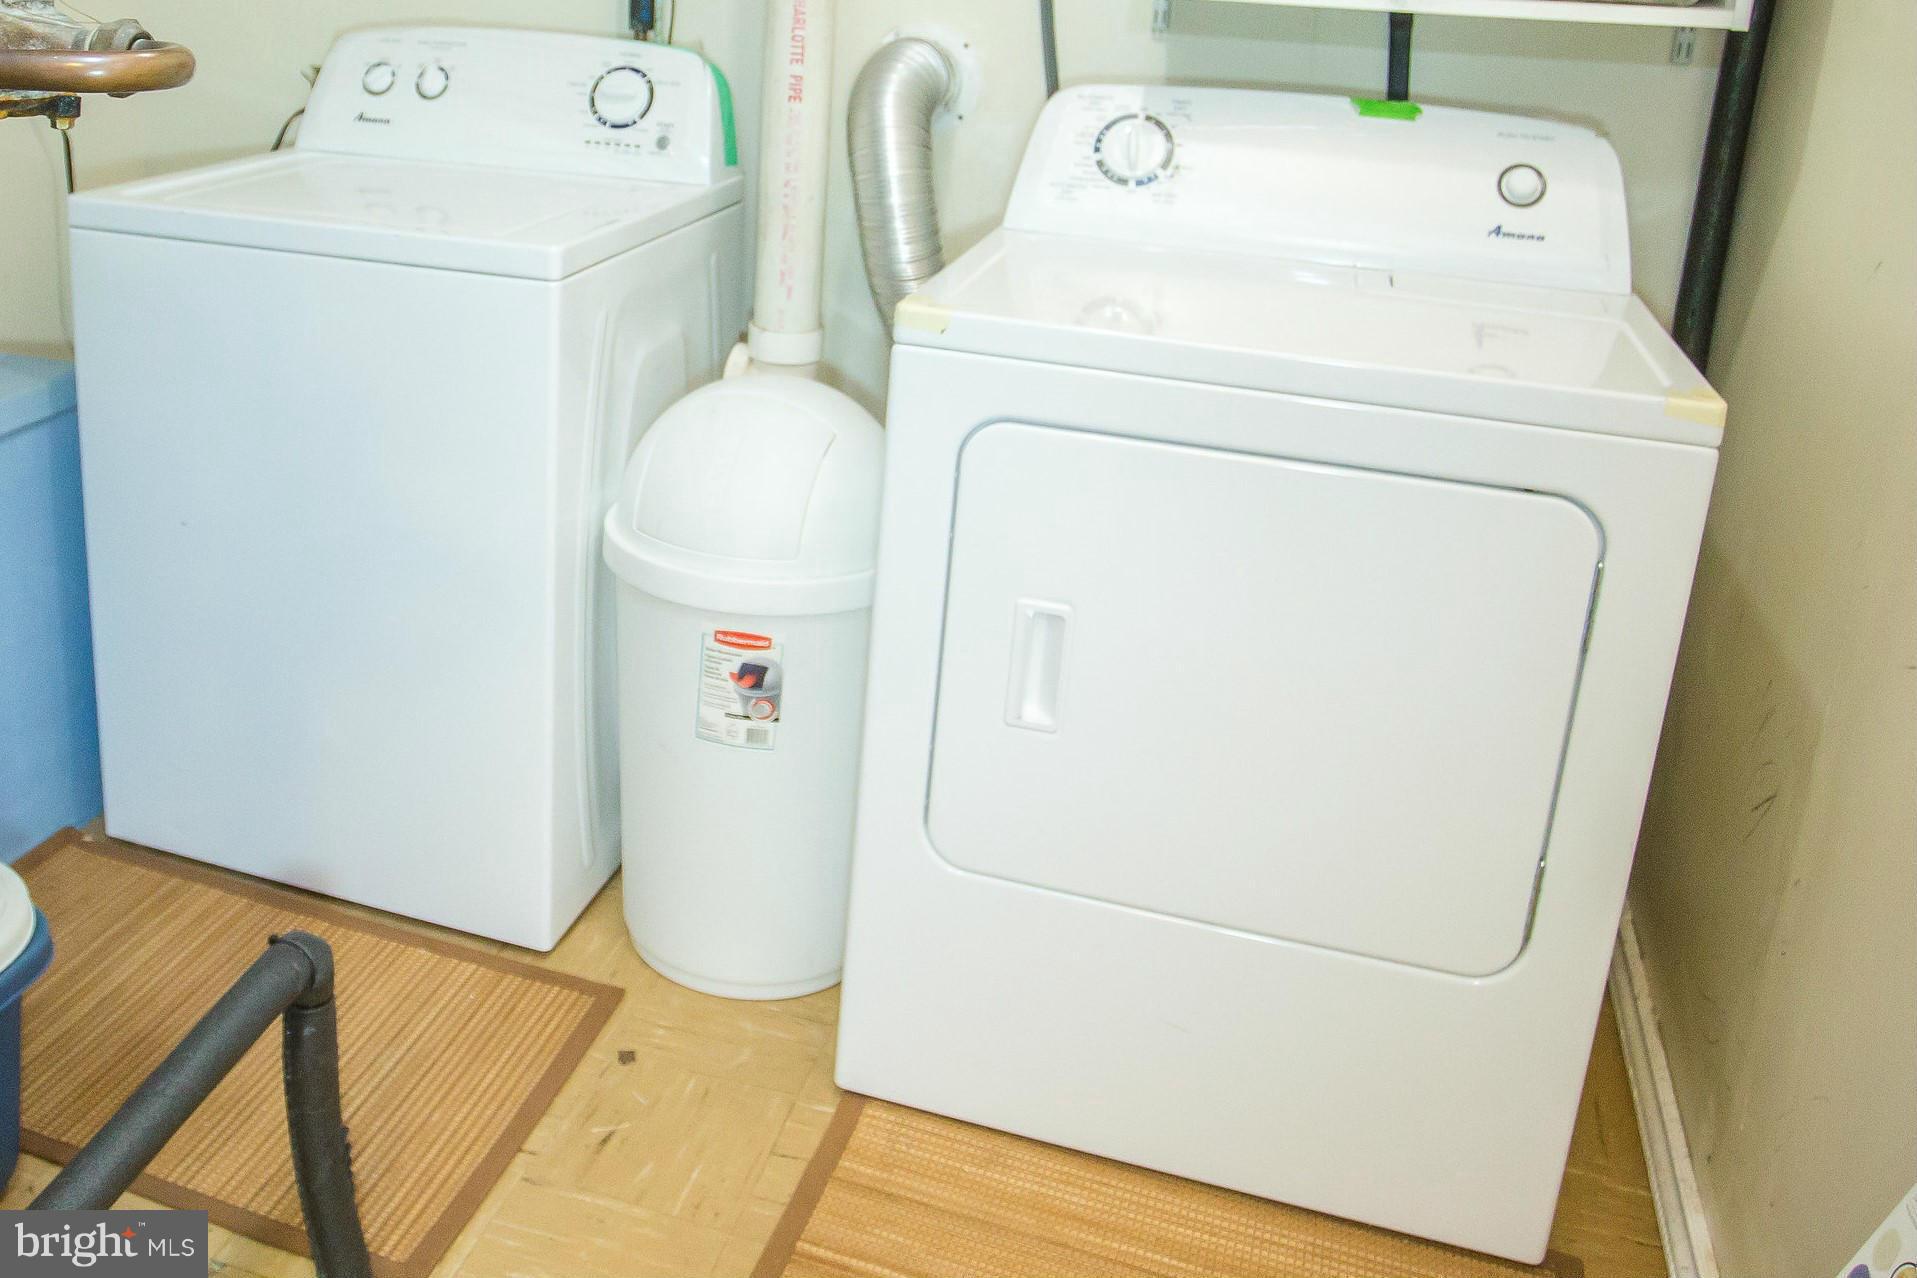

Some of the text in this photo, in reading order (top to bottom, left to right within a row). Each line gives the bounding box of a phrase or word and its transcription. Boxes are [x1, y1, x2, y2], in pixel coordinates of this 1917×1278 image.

[787, 74, 804, 104] PIPE
[353, 111, 391, 125] Amana
[1487, 224, 1546, 241] Amana
[715, 633, 770, 648] Rubbermaid
